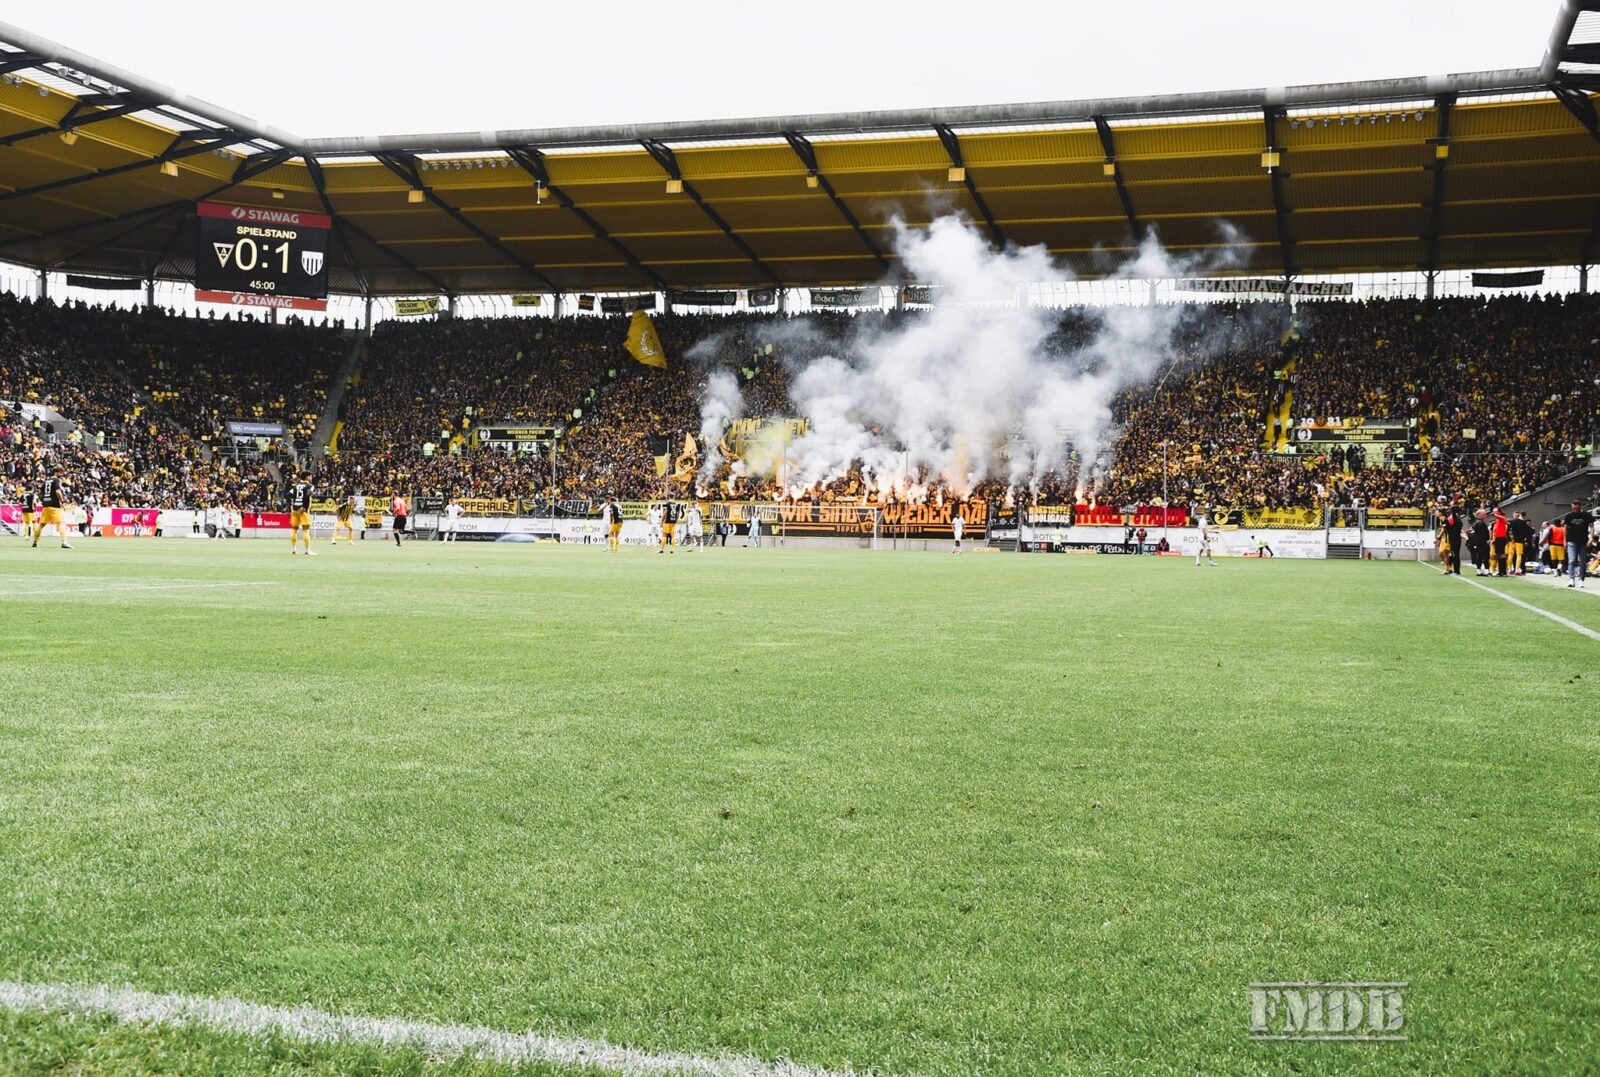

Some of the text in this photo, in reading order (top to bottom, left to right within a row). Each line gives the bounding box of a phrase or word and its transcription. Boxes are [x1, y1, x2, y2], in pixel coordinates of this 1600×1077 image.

[248, 209, 299, 223] STAWAG
[237, 226, 297, 239] SPIELSTAND
[235, 238, 289, 273] 0:1
[250, 280, 275, 290] 45:00
[1177, 279, 1353, 295] ALEMANNIA AACHEN
[247, 296, 292, 307] STAWAG
[779, 501, 812, 522] WIR
[819, 501, 857, 523] SIND
[884, 502, 952, 524] WIEDER
[1029, 515, 1070, 524] HOOLIGANS
[1385, 539, 1425, 548] ROTCOM
